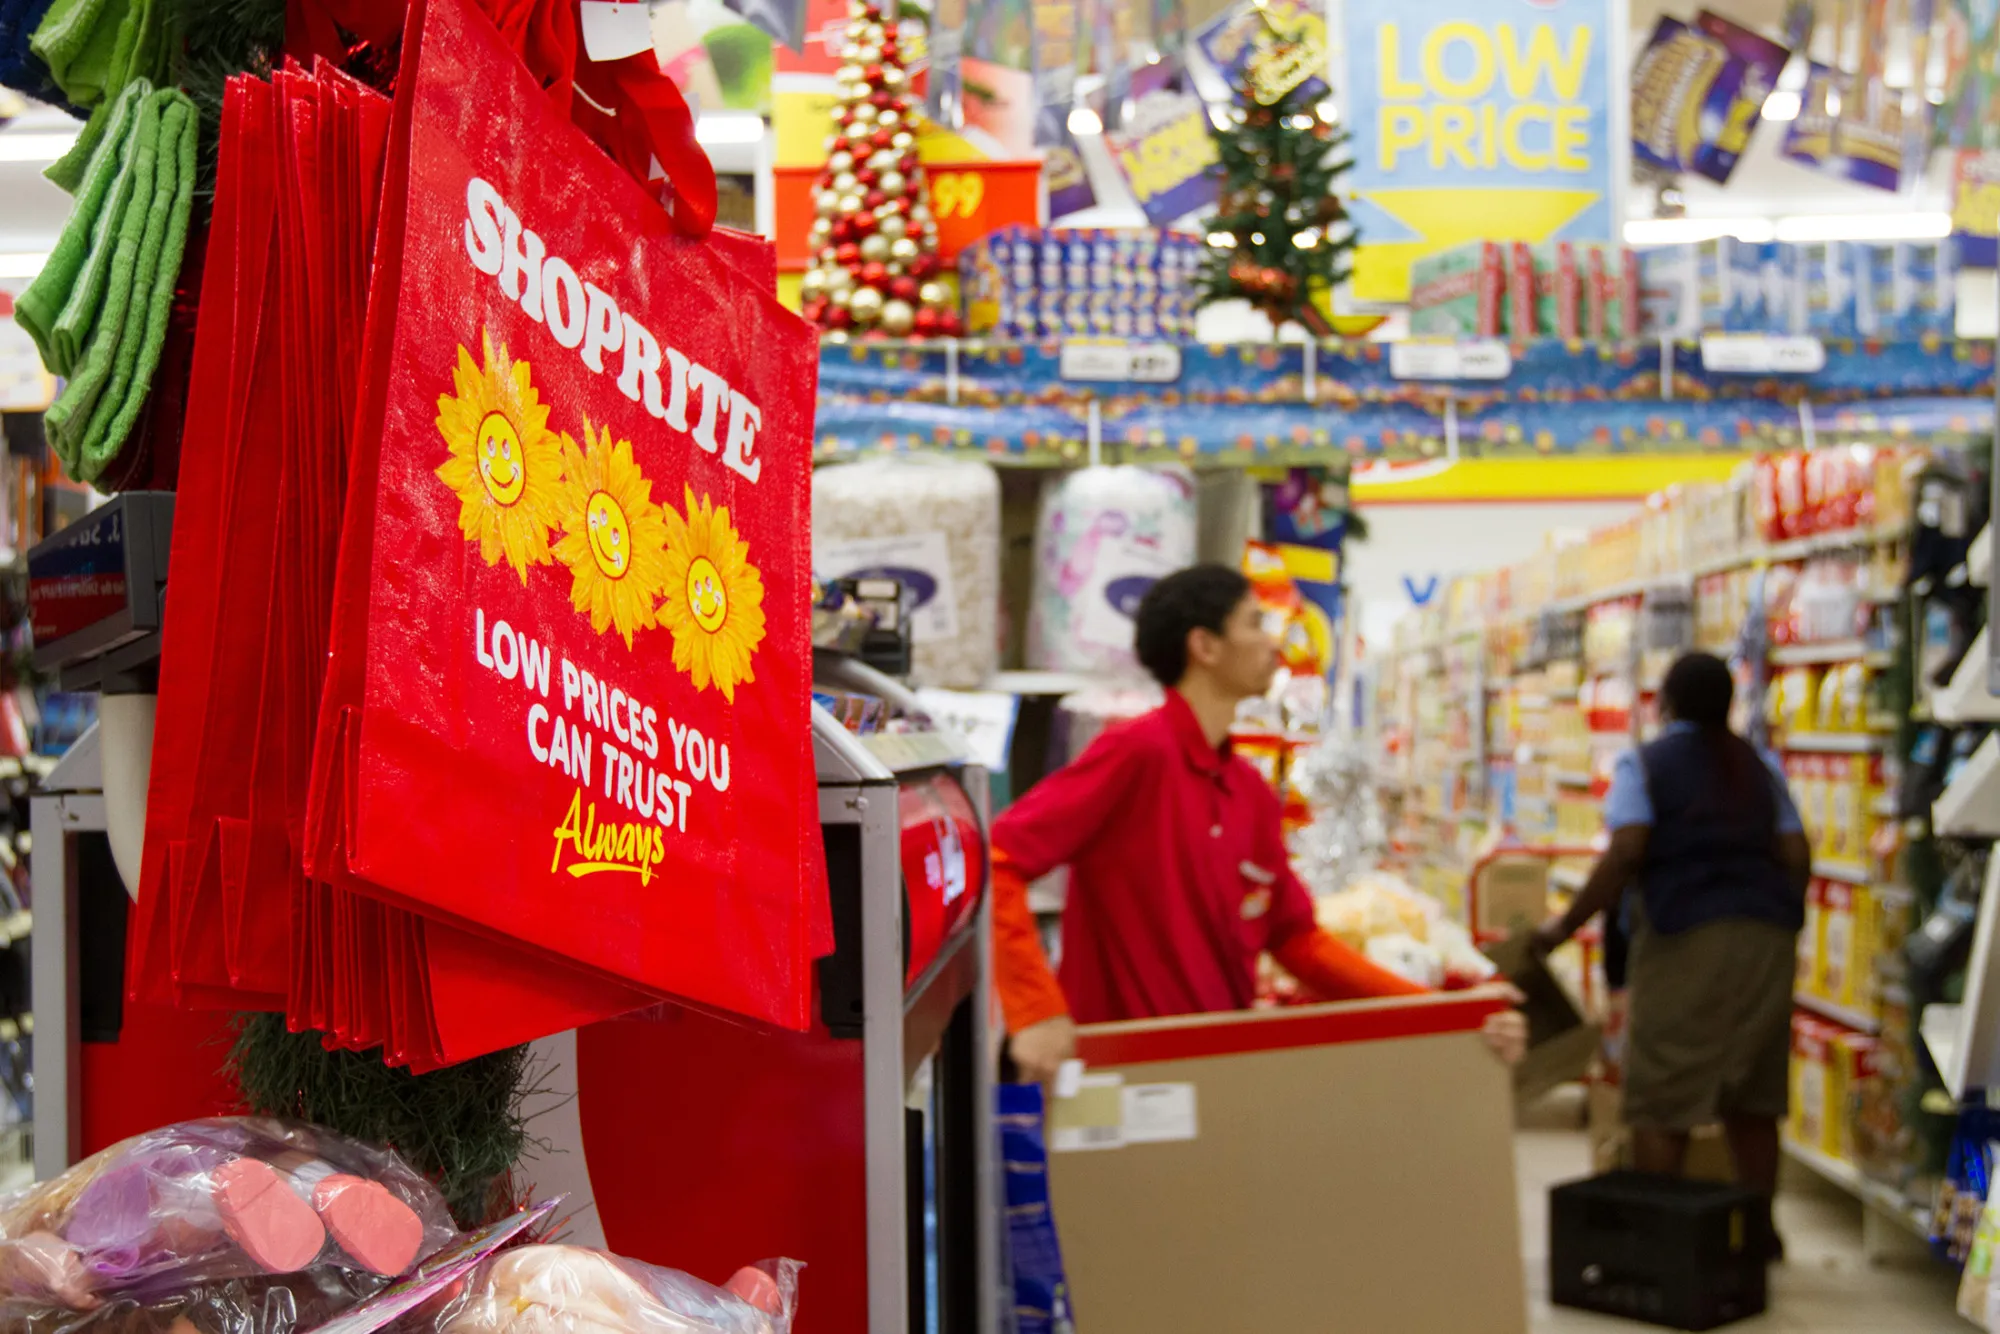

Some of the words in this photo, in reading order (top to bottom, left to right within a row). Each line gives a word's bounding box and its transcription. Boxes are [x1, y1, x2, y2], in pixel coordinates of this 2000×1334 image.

[1380, 22, 1591, 100] LOW
[1380, 104, 1590, 171] PRICE
[465, 177, 761, 484] SHOPRITE
[476, 608, 549, 697] LOW
[562, 658, 658, 759] PRICES
[668, 717, 729, 791] YOU
[528, 704, 592, 787] CAN
[602, 742, 692, 833] TRUST
[551, 787, 665, 887] Always
